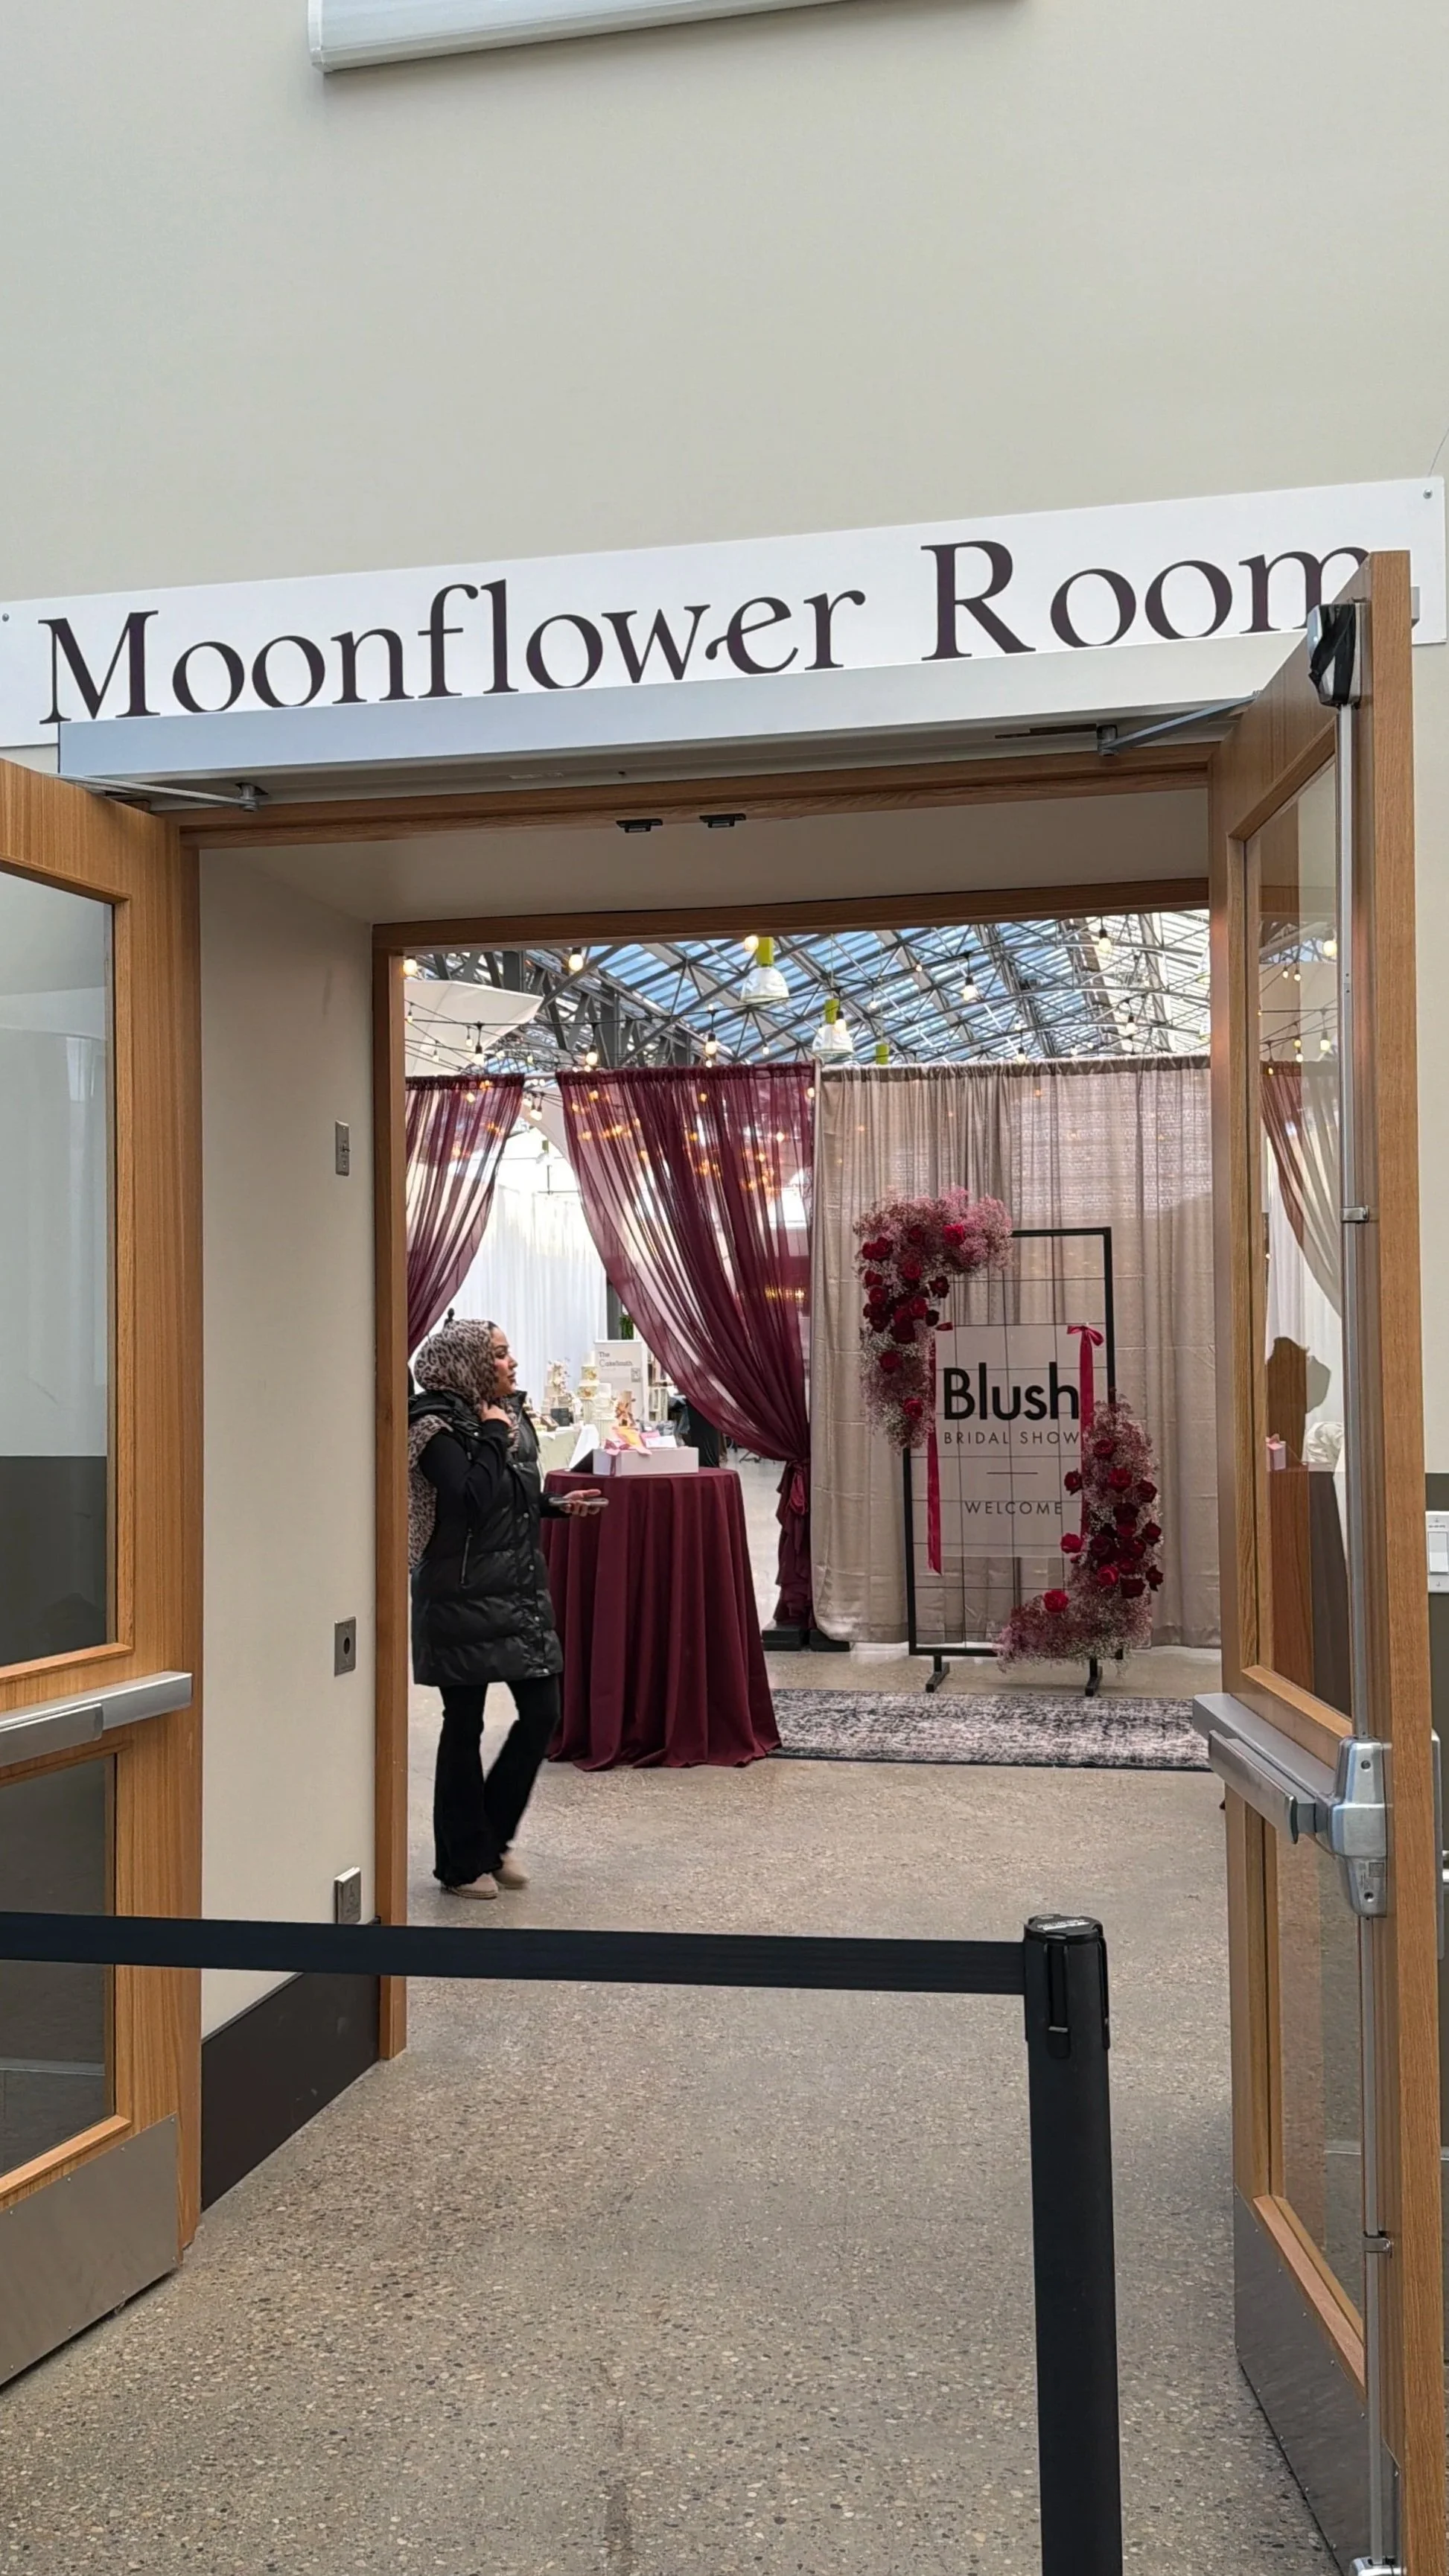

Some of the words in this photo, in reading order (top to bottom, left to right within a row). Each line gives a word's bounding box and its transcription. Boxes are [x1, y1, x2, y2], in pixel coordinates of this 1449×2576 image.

[37, 578, 865, 725] Moonflower
[920, 539, 1369, 661] Room
[943, 1361, 1079, 1420] Blush
[943, 1431, 1009, 1445] BRIDAL
[1020, 1431, 1080, 1444] SHOW
[965, 1501, 1063, 1515] WELCOME
